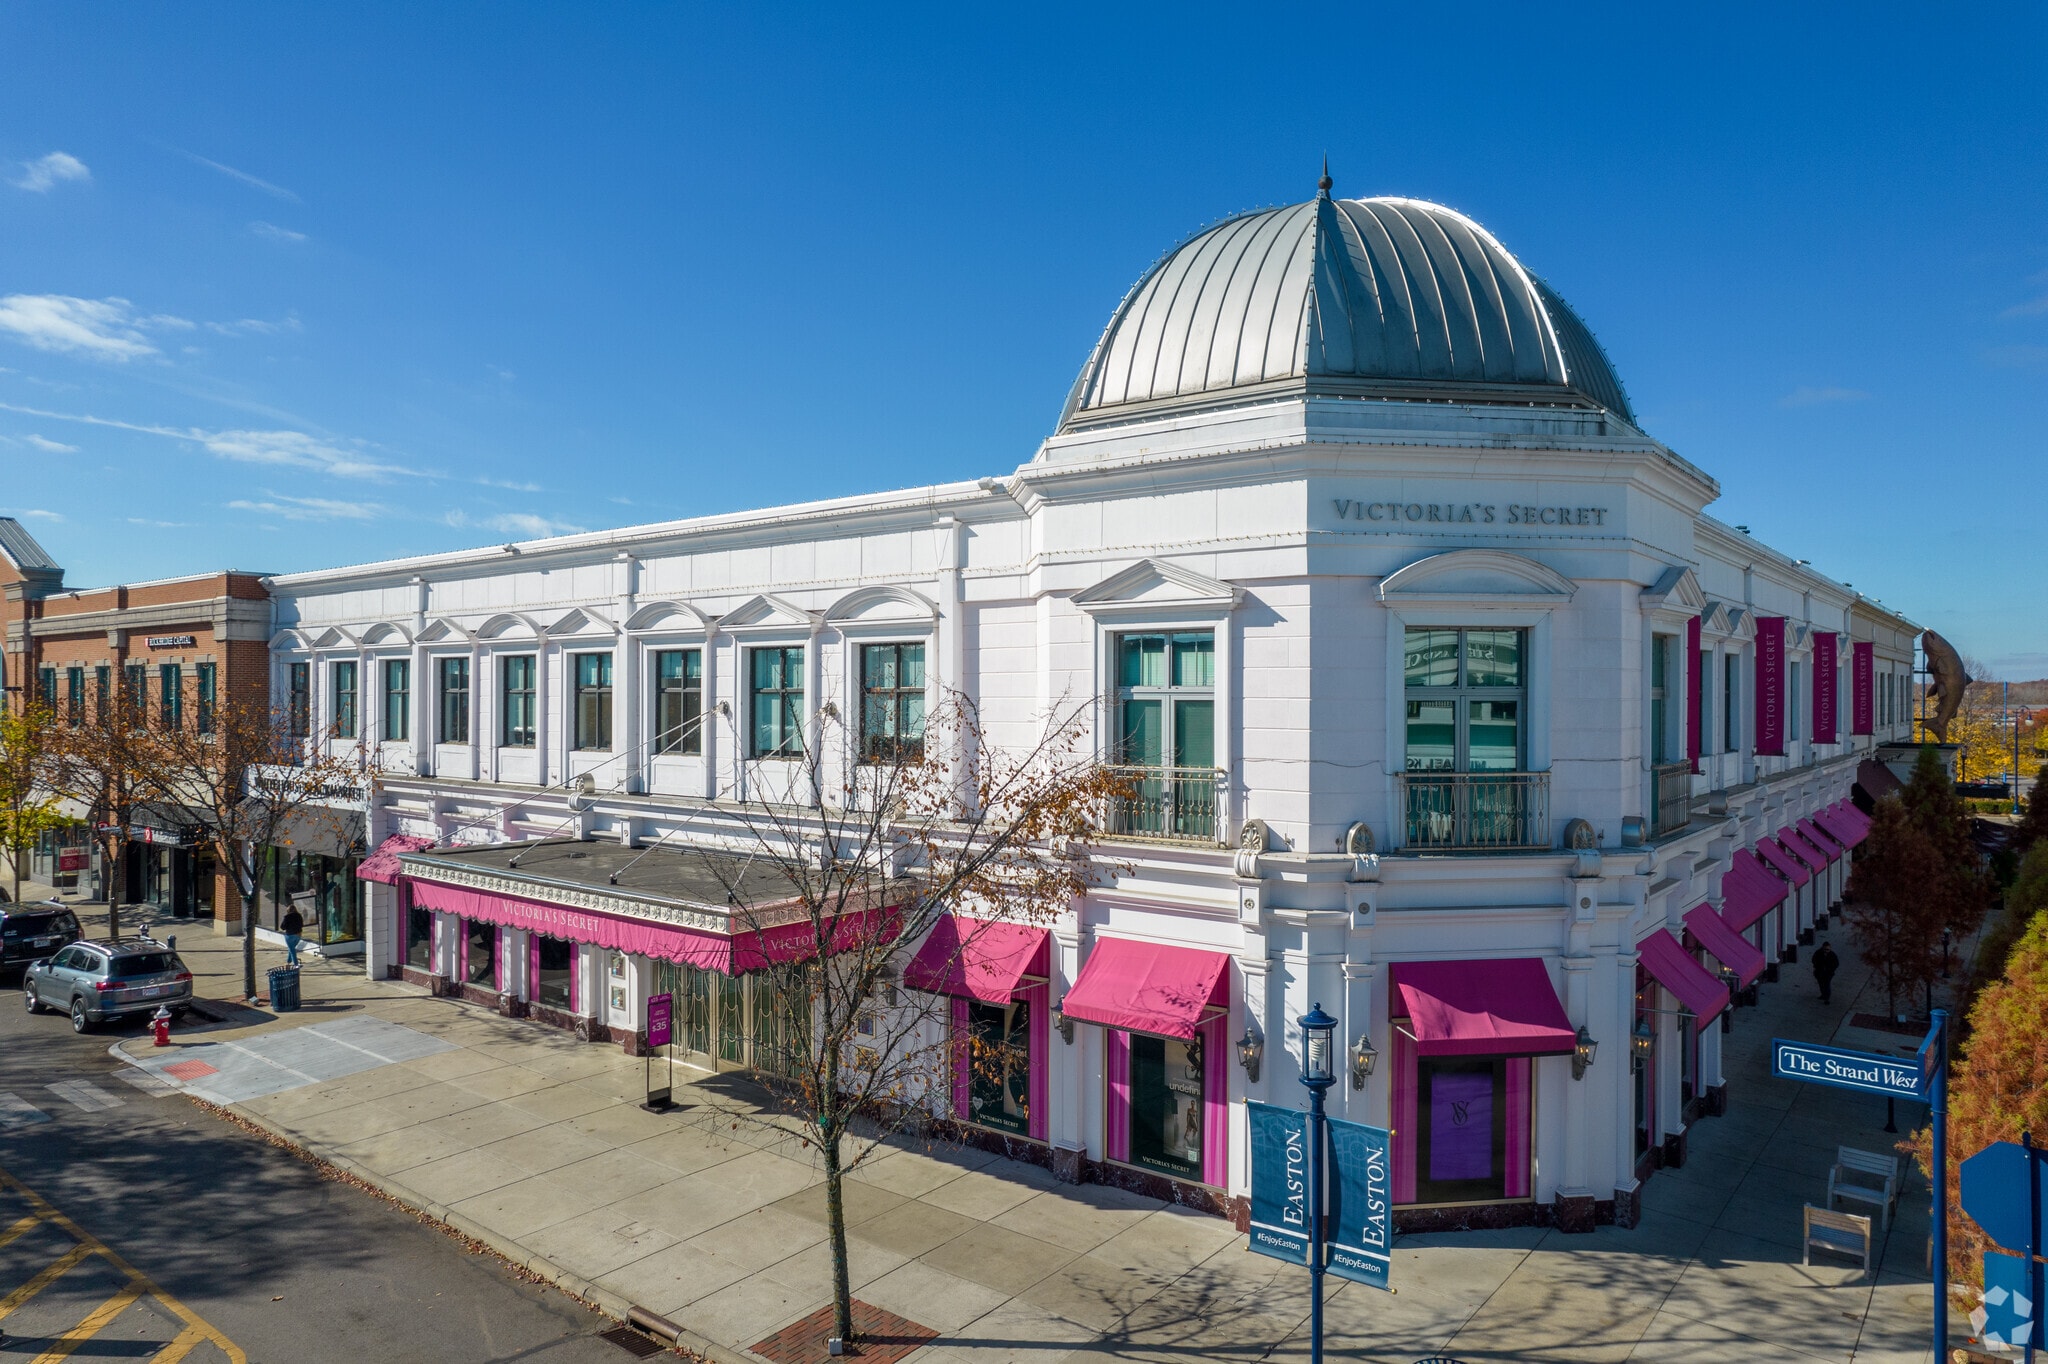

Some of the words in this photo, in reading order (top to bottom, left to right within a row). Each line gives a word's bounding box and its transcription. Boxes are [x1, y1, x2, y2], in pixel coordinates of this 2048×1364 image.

[1334, 499, 1496, 523] VICTORIA'S
[1508, 503, 1608, 526] SECRET
[1766, 633, 1775, 673] SECRET
[1821, 645, 1830, 678] SECRET
[1764, 677, 1775, 740] VICTORIA'S
[1820, 681, 1830, 731] VICTORIA'S
[1859, 682, 1867, 725] VICTORIA'S
[503, 900, 557, 924] VICTORIA'S
[560, 912, 599, 932] SECRET
[652, 1021, 667, 1032] $35
[1784, 1052, 1821, 1072] The
[1825, 1059, 1879, 1082] Strand
[1883, 1068, 1918, 1089] West
[1003, 1119, 1019, 1128] SECRET
[1142, 1156, 1171, 1168] VICTORIA'S
[1171, 1163, 1190, 1173] SECRET
[1257, 1232, 1301, 1251] #EnjoyEaston
[1334, 1253, 1381, 1273] #EnjoyEaston
